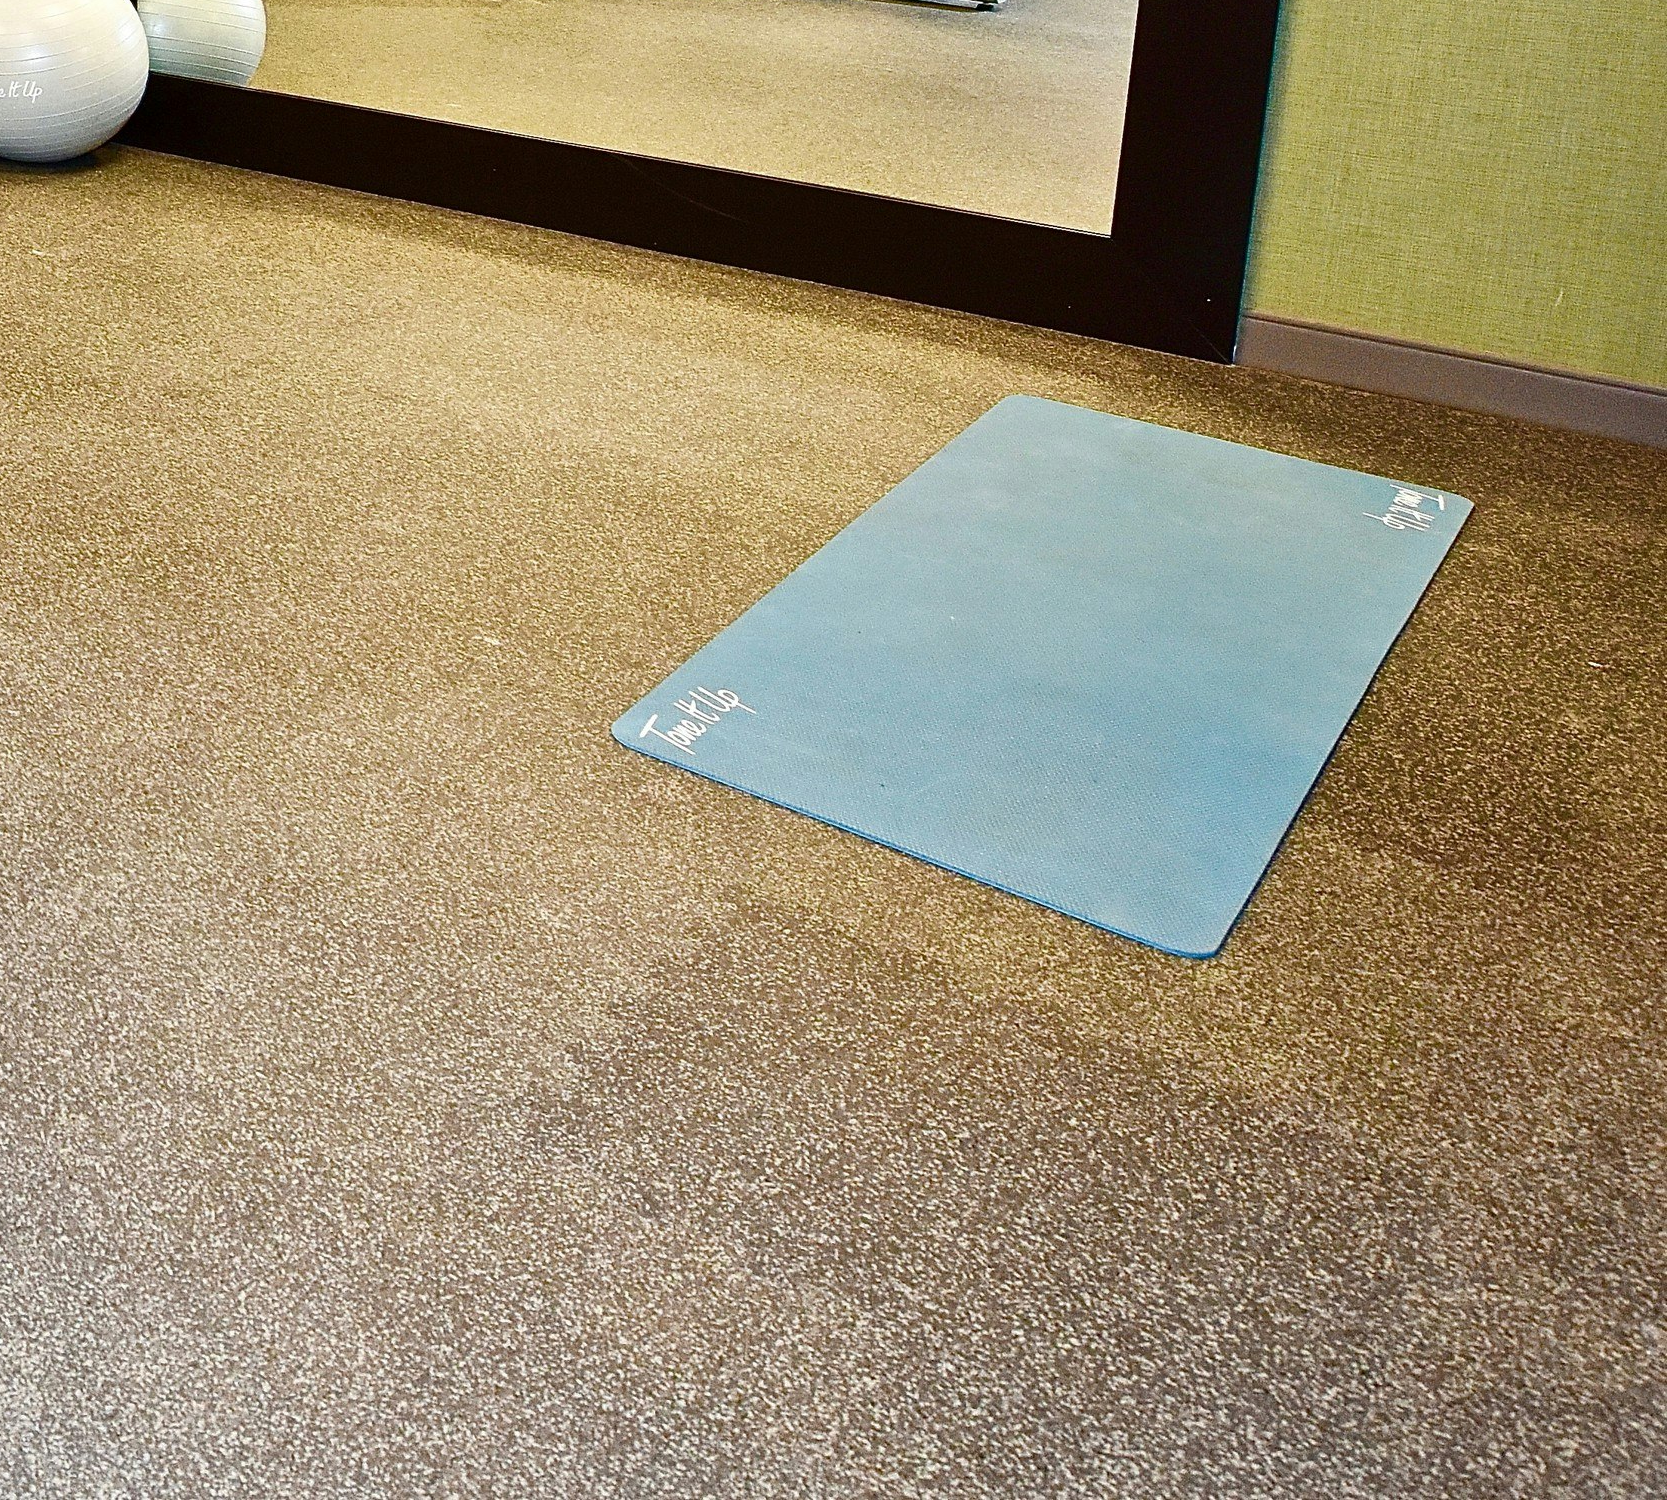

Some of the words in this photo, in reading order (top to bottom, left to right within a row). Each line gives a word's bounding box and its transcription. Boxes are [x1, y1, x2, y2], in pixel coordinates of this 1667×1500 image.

[8, 81, 22, 97] It
[22, 80, 43, 104] Up
[1390, 484, 1445, 511] Tone
[1362, 512, 1431, 531] Up
[1388, 504, 1435, 522] It
[673, 699, 721, 725] It
[688, 686, 757, 714] Up
[639, 713, 707, 755] Tone
